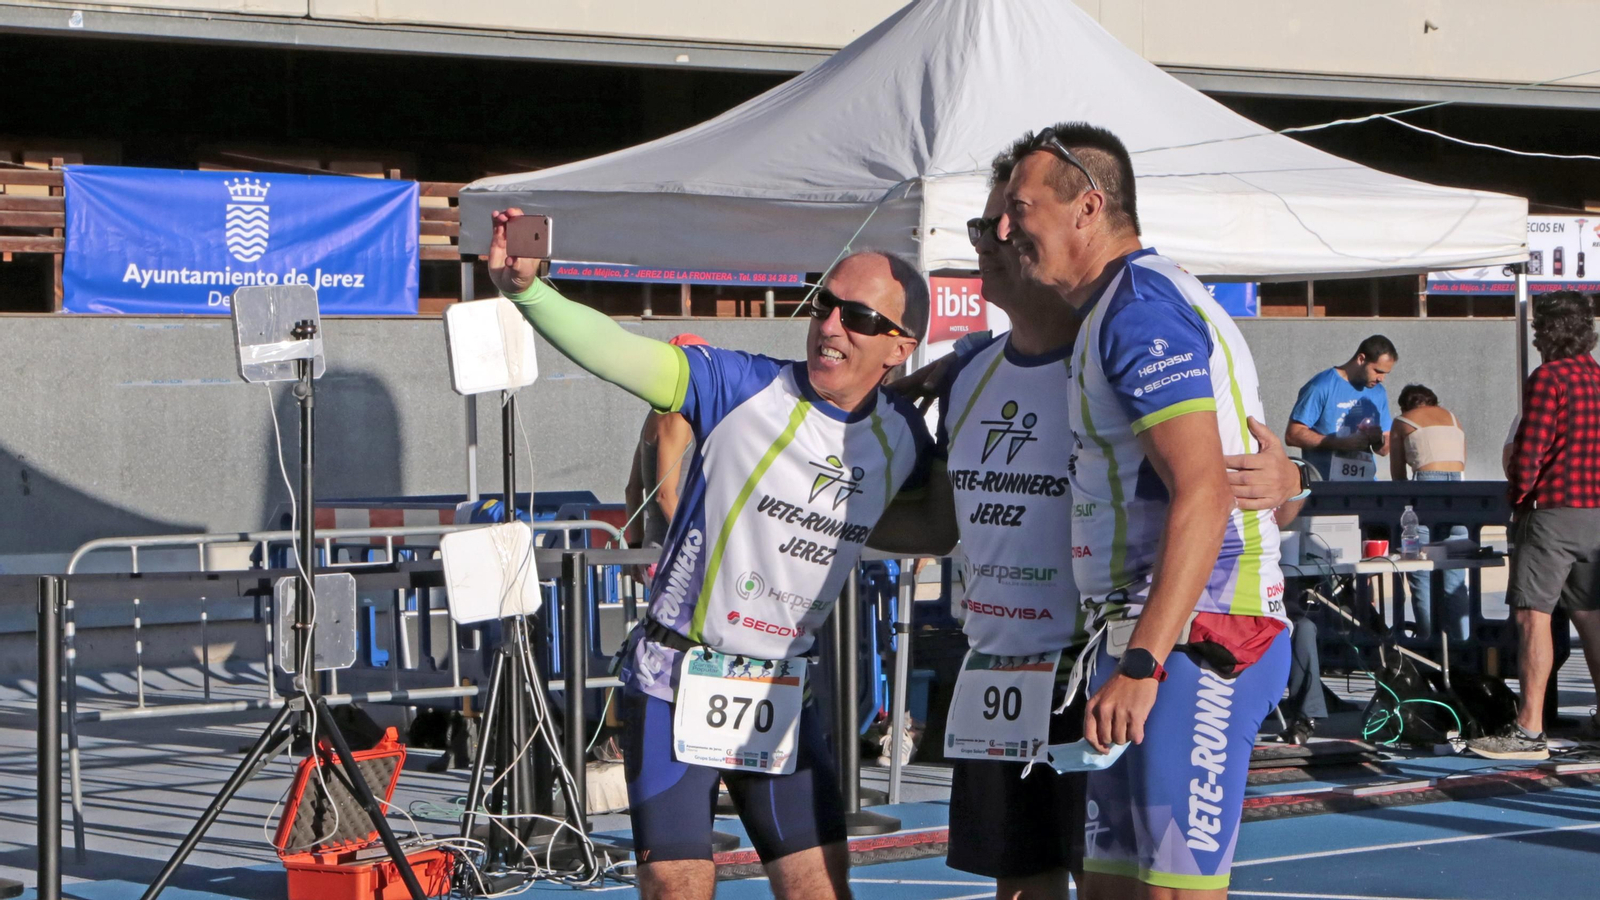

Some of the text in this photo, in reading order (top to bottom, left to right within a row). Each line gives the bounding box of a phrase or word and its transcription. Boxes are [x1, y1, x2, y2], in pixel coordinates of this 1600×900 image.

[1553, 223, 1565, 233] EN
[122, 263, 365, 291] Ayuntamiento de Jerez
[557, 266, 580, 276] Avda.
[582, 268, 592, 276] de
[623, 269, 630, 277] 2
[635, 270, 662, 279] JEREZ
[663, 271, 676, 279] DE
[676, 271, 688, 280] LA
[689, 272, 733, 281] FRONTERA
[739, 273, 751, 281] Tel.
[753, 273, 766, 282] 956
[768, 273, 777, 282] 34
[937, 286, 981, 317] ibis
[1144, 368, 1208, 394] SECOVISA
[1341, 463, 1366, 478] 891
[970, 502, 1026, 527] JEREZ
[778, 536, 838, 566] JEREZ
[967, 599, 1054, 620] SECOVISA
[706, 694, 775, 733] 870
[983, 686, 1022, 722] 90
